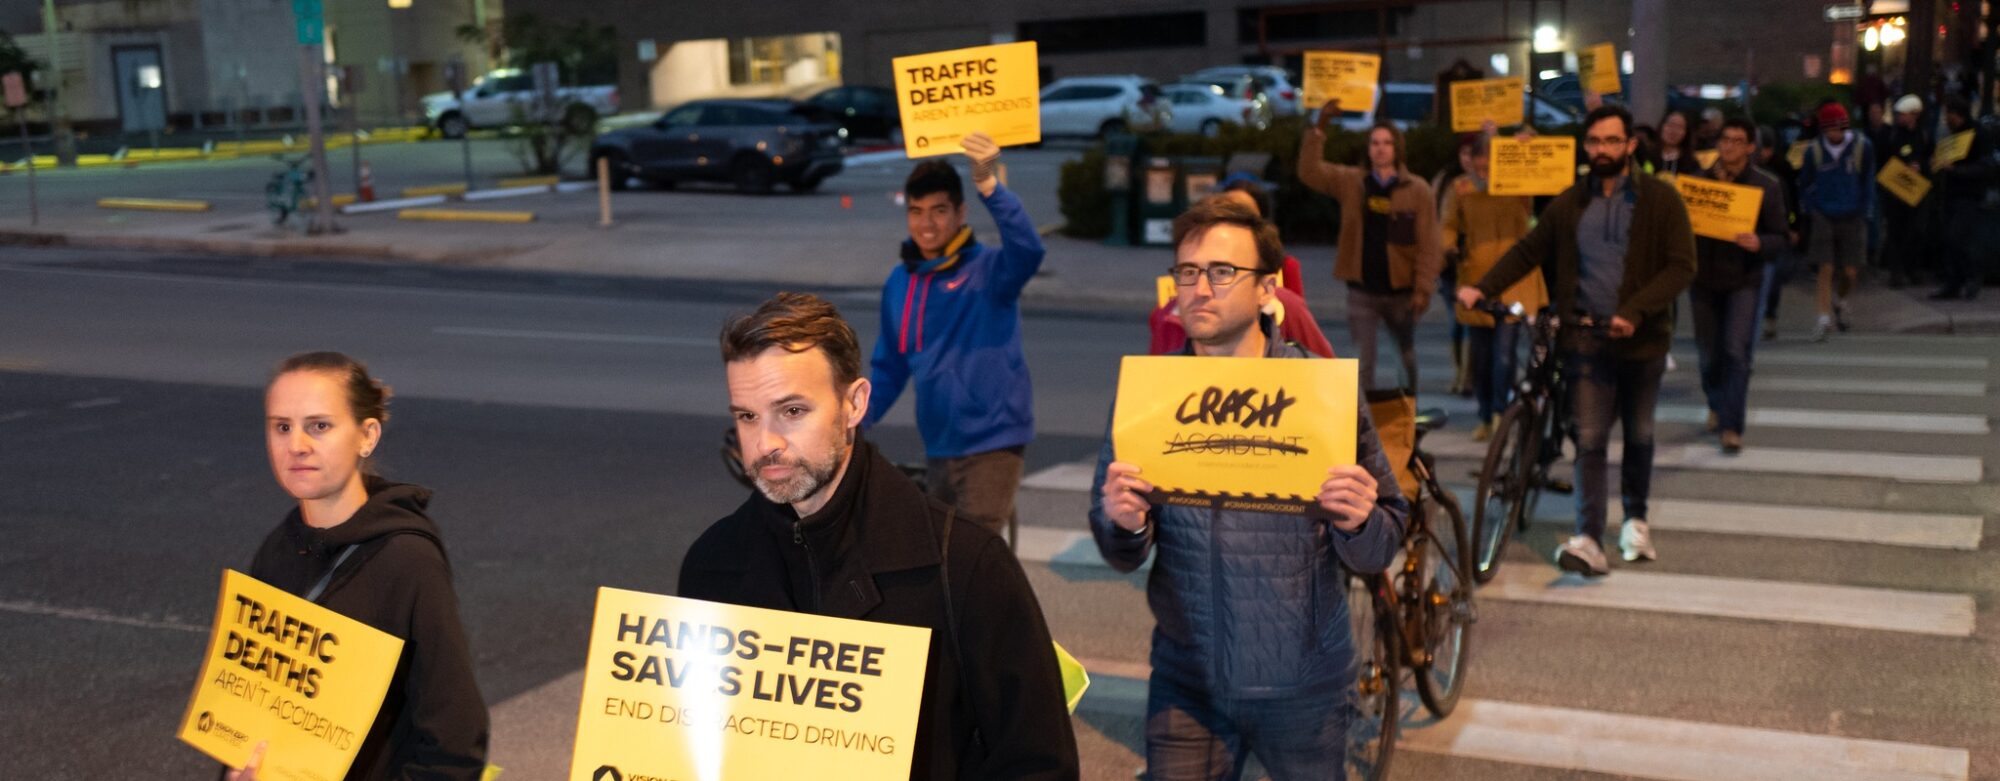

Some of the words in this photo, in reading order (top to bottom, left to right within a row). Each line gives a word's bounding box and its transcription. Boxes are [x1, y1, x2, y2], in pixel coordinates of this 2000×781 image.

[906, 58, 998, 84] TRAFFIC
[910, 80, 996, 106] DEATHS
[912, 105, 961, 122] AREN'T
[964, 96, 1033, 115] ACCIDENTS
[1175, 386, 1297, 428] CRASH
[1168, 432, 1304, 457] ACCIDENT
[236, 593, 340, 664] TRAFFIC
[616, 613, 886, 677] HANDS-FREE
[223, 630, 323, 699] DEATHS
[610, 650, 743, 697] SAVS
[752, 670, 865, 713] LIVES
[214, 669, 271, 707] AREN'T
[269, 695, 356, 751] ACCIDENTS
[604, 697, 654, 720] END
[659, 705, 799, 741] DISACTED
[804, 725, 895, 755] DRIVING
